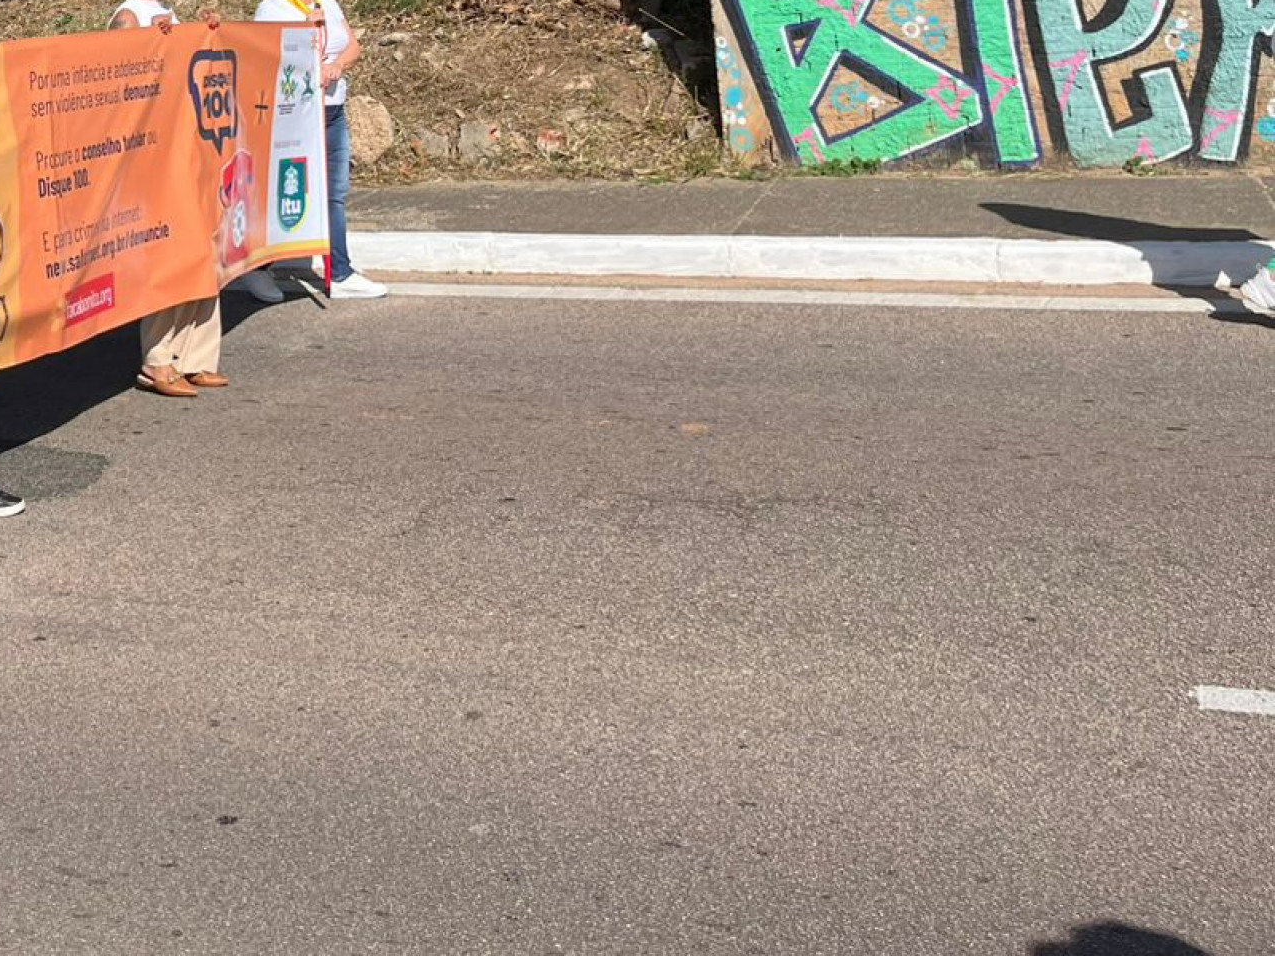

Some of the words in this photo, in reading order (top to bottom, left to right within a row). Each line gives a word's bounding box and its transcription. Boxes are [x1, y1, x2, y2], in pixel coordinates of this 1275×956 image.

[29, 71, 49, 90] Por
[50, 70, 70, 88] uma
[31, 100, 54, 117] sem
[38, 176, 72, 199] Disque
